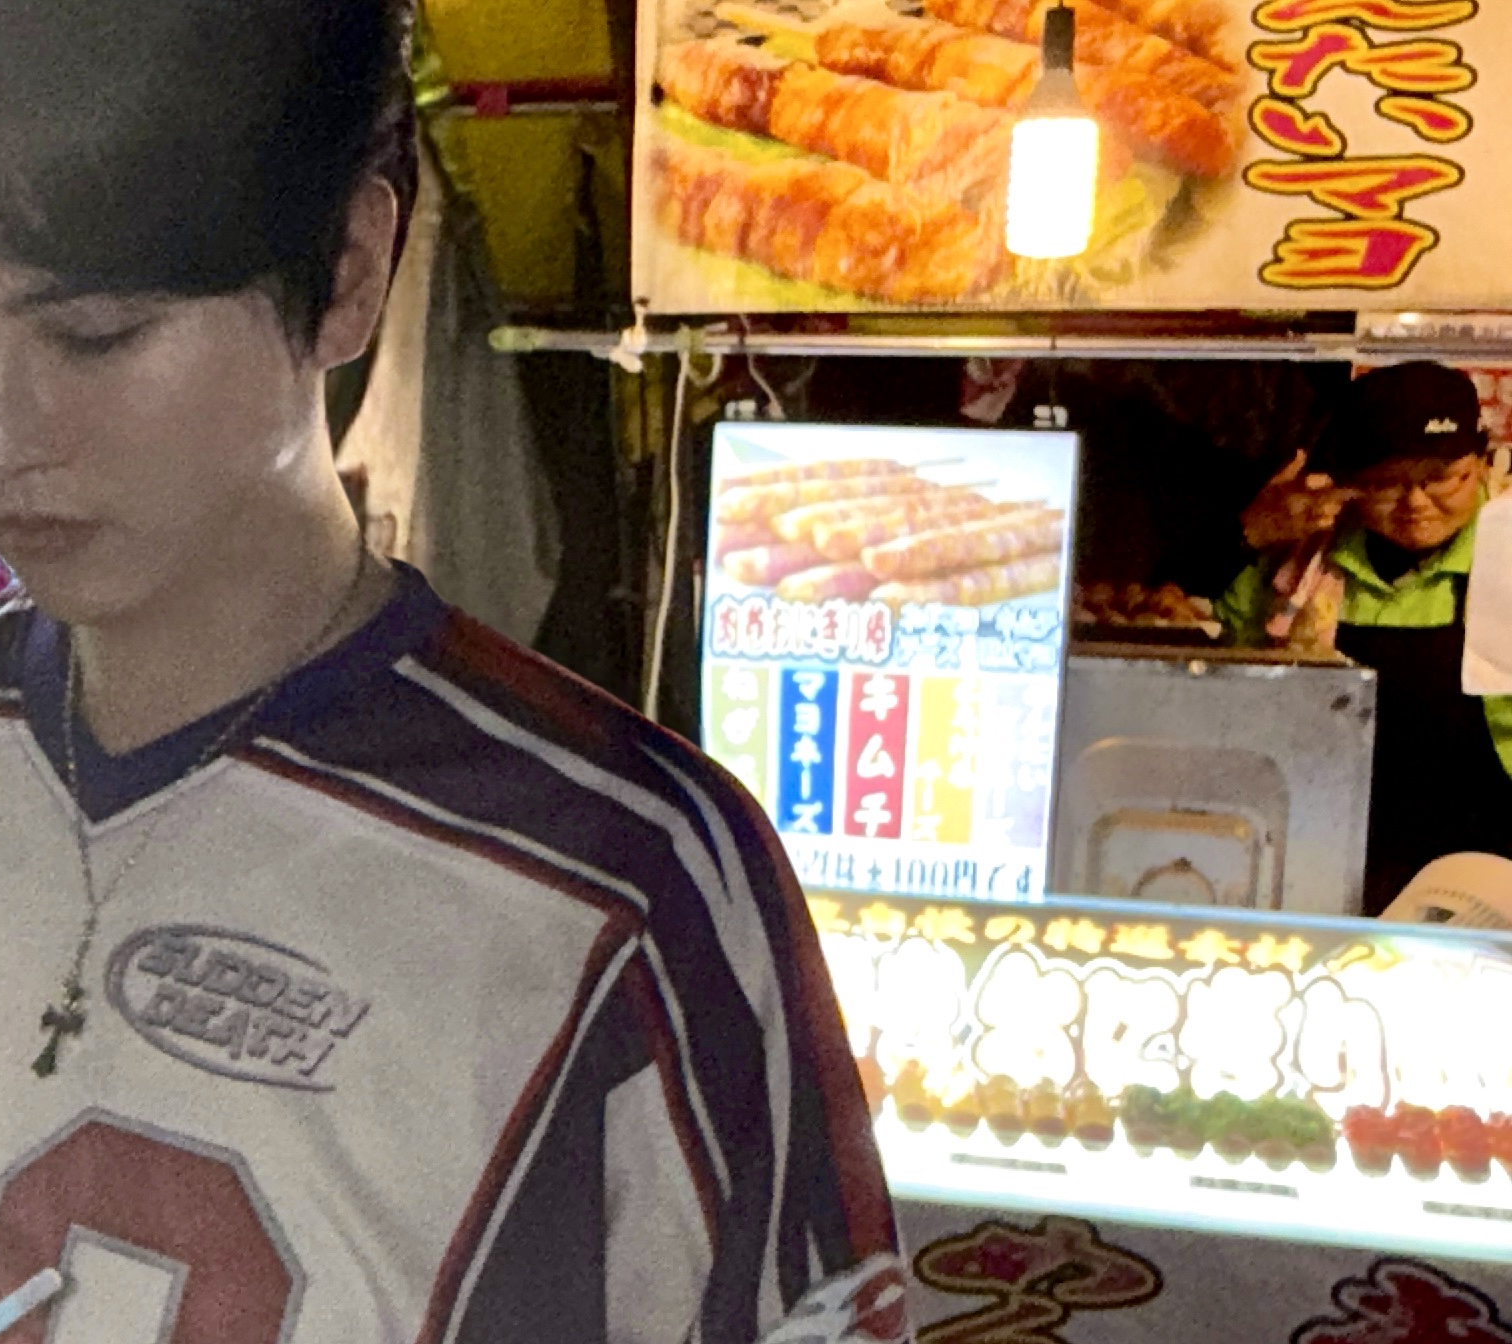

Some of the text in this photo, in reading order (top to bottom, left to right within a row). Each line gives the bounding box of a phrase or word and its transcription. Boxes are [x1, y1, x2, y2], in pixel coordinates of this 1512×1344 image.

[789, 669, 826, 835] マヨネーズ
[852, 672, 900, 837] キムチ
[138, 924, 372, 1039] SUDDEN
[140, 981, 336, 1077] DEATH
